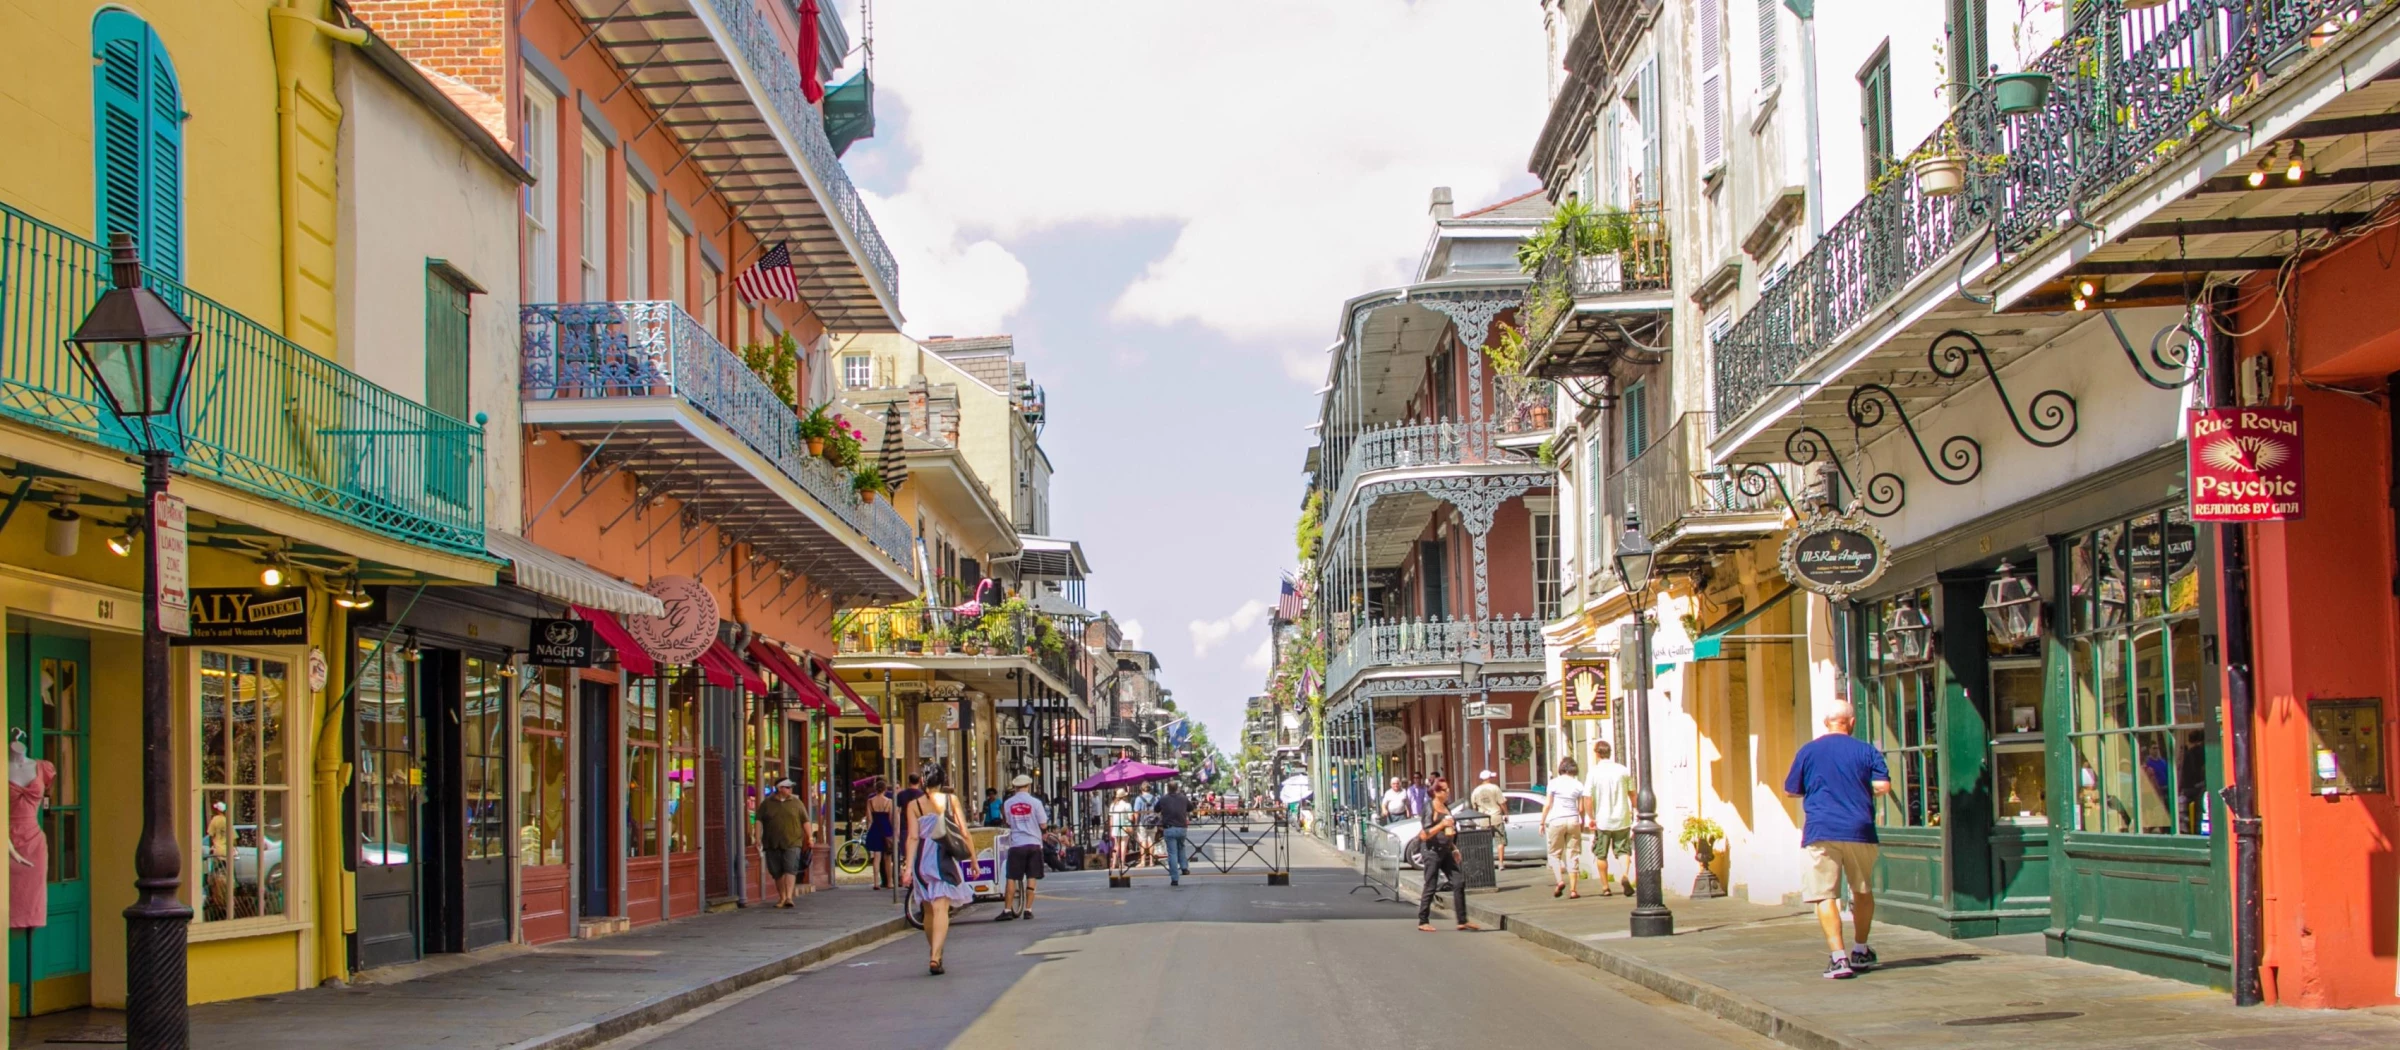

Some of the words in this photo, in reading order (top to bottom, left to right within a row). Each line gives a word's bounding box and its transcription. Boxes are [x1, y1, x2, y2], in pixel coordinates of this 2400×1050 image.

[2195, 418, 2234, 438] Rue
[2241, 412, 2297, 436] Royal
[2196, 475, 2297, 500] Psychic
[2195, 503, 2251, 515] READINGS
[2252, 502, 2270, 514] BY
[2271, 502, 2299, 514] GINA
[161, 535, 184, 553] LOADING
[166, 557, 180, 572] ZONE
[1838, 549, 1872, 566] Antiques
[98, 600, 113, 620] 631
[190, 594, 252, 624] ALY
[252, 601, 298, 618] DIRECT
[193, 628, 216, 638] Men's
[217, 628, 233, 637] and
[234, 628, 269, 637] Women's
[271, 627, 302, 638] Apparel
[536, 644, 585, 659] NAGHI'S
[636, 637, 668, 661] FISCHER
[673, 638, 711, 662] GAMBINO
